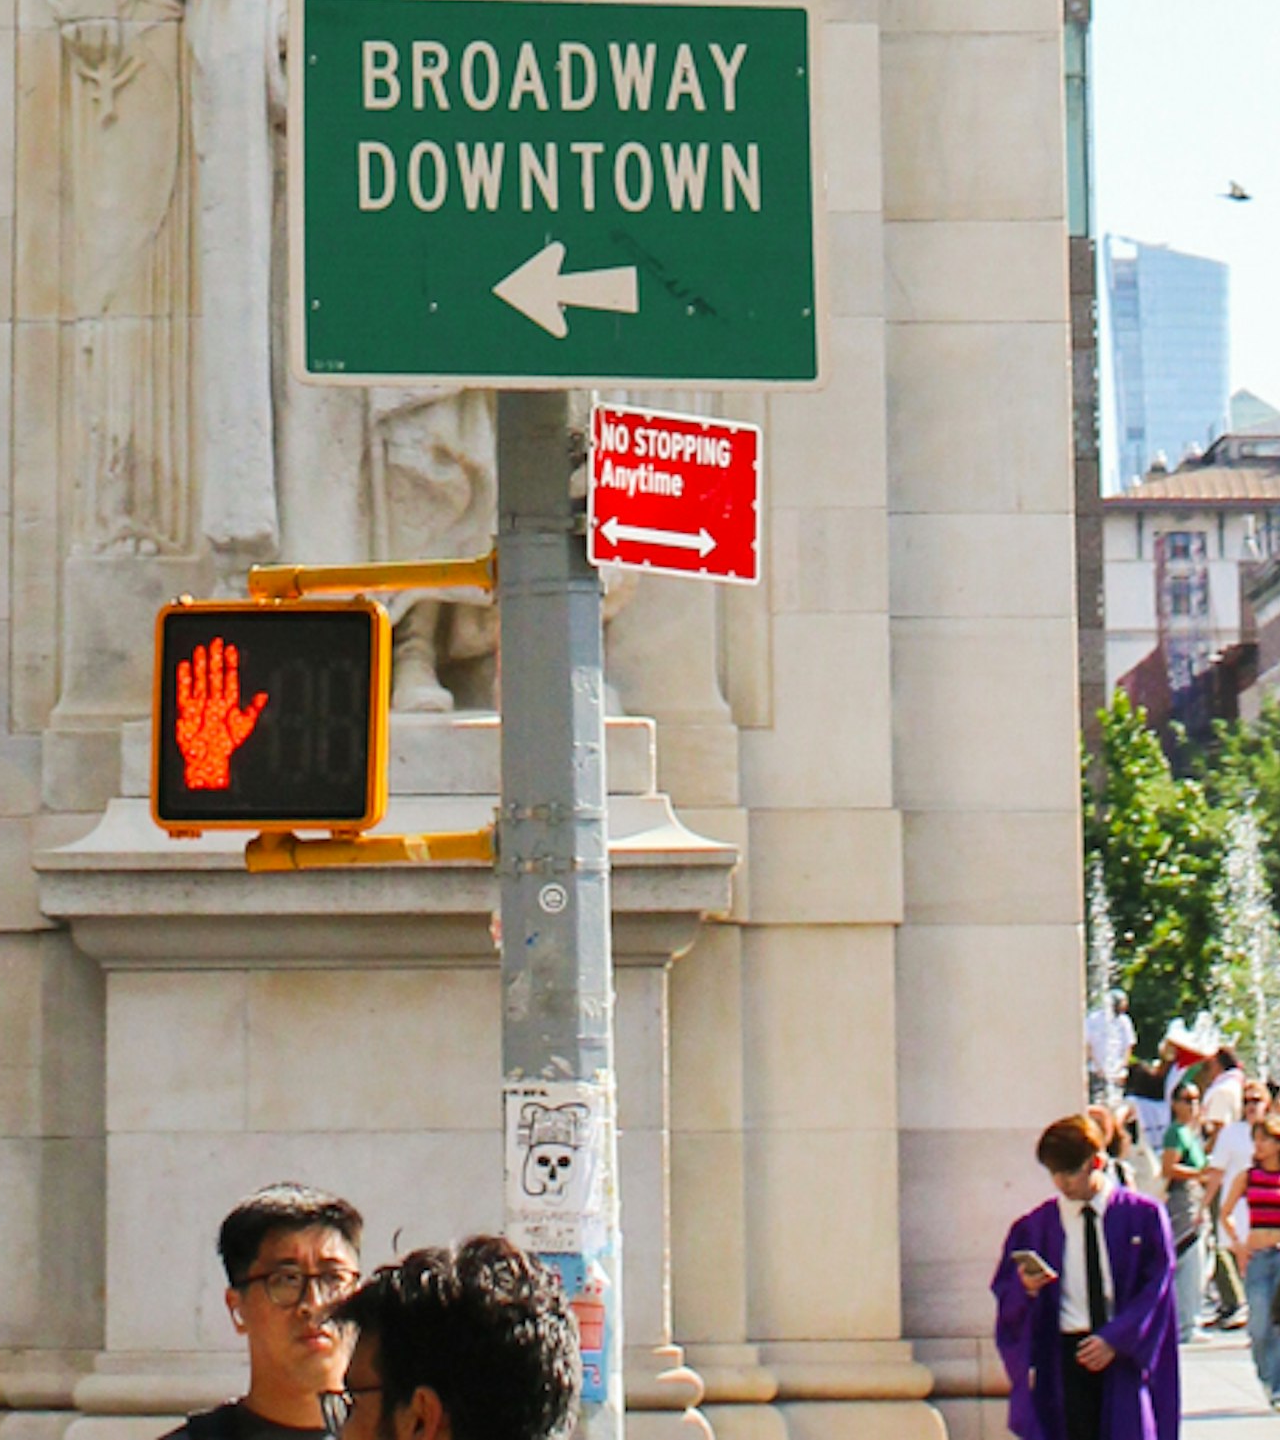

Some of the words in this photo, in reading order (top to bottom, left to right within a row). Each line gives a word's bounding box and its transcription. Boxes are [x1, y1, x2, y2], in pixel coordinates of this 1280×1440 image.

[361, 40, 748, 112] BROADWAY
[357, 140, 762, 213] DOWNTOWN
[601, 422, 629, 454] NO
[634, 426, 732, 469] STOPPING
[601, 458, 684, 498] Anytime
